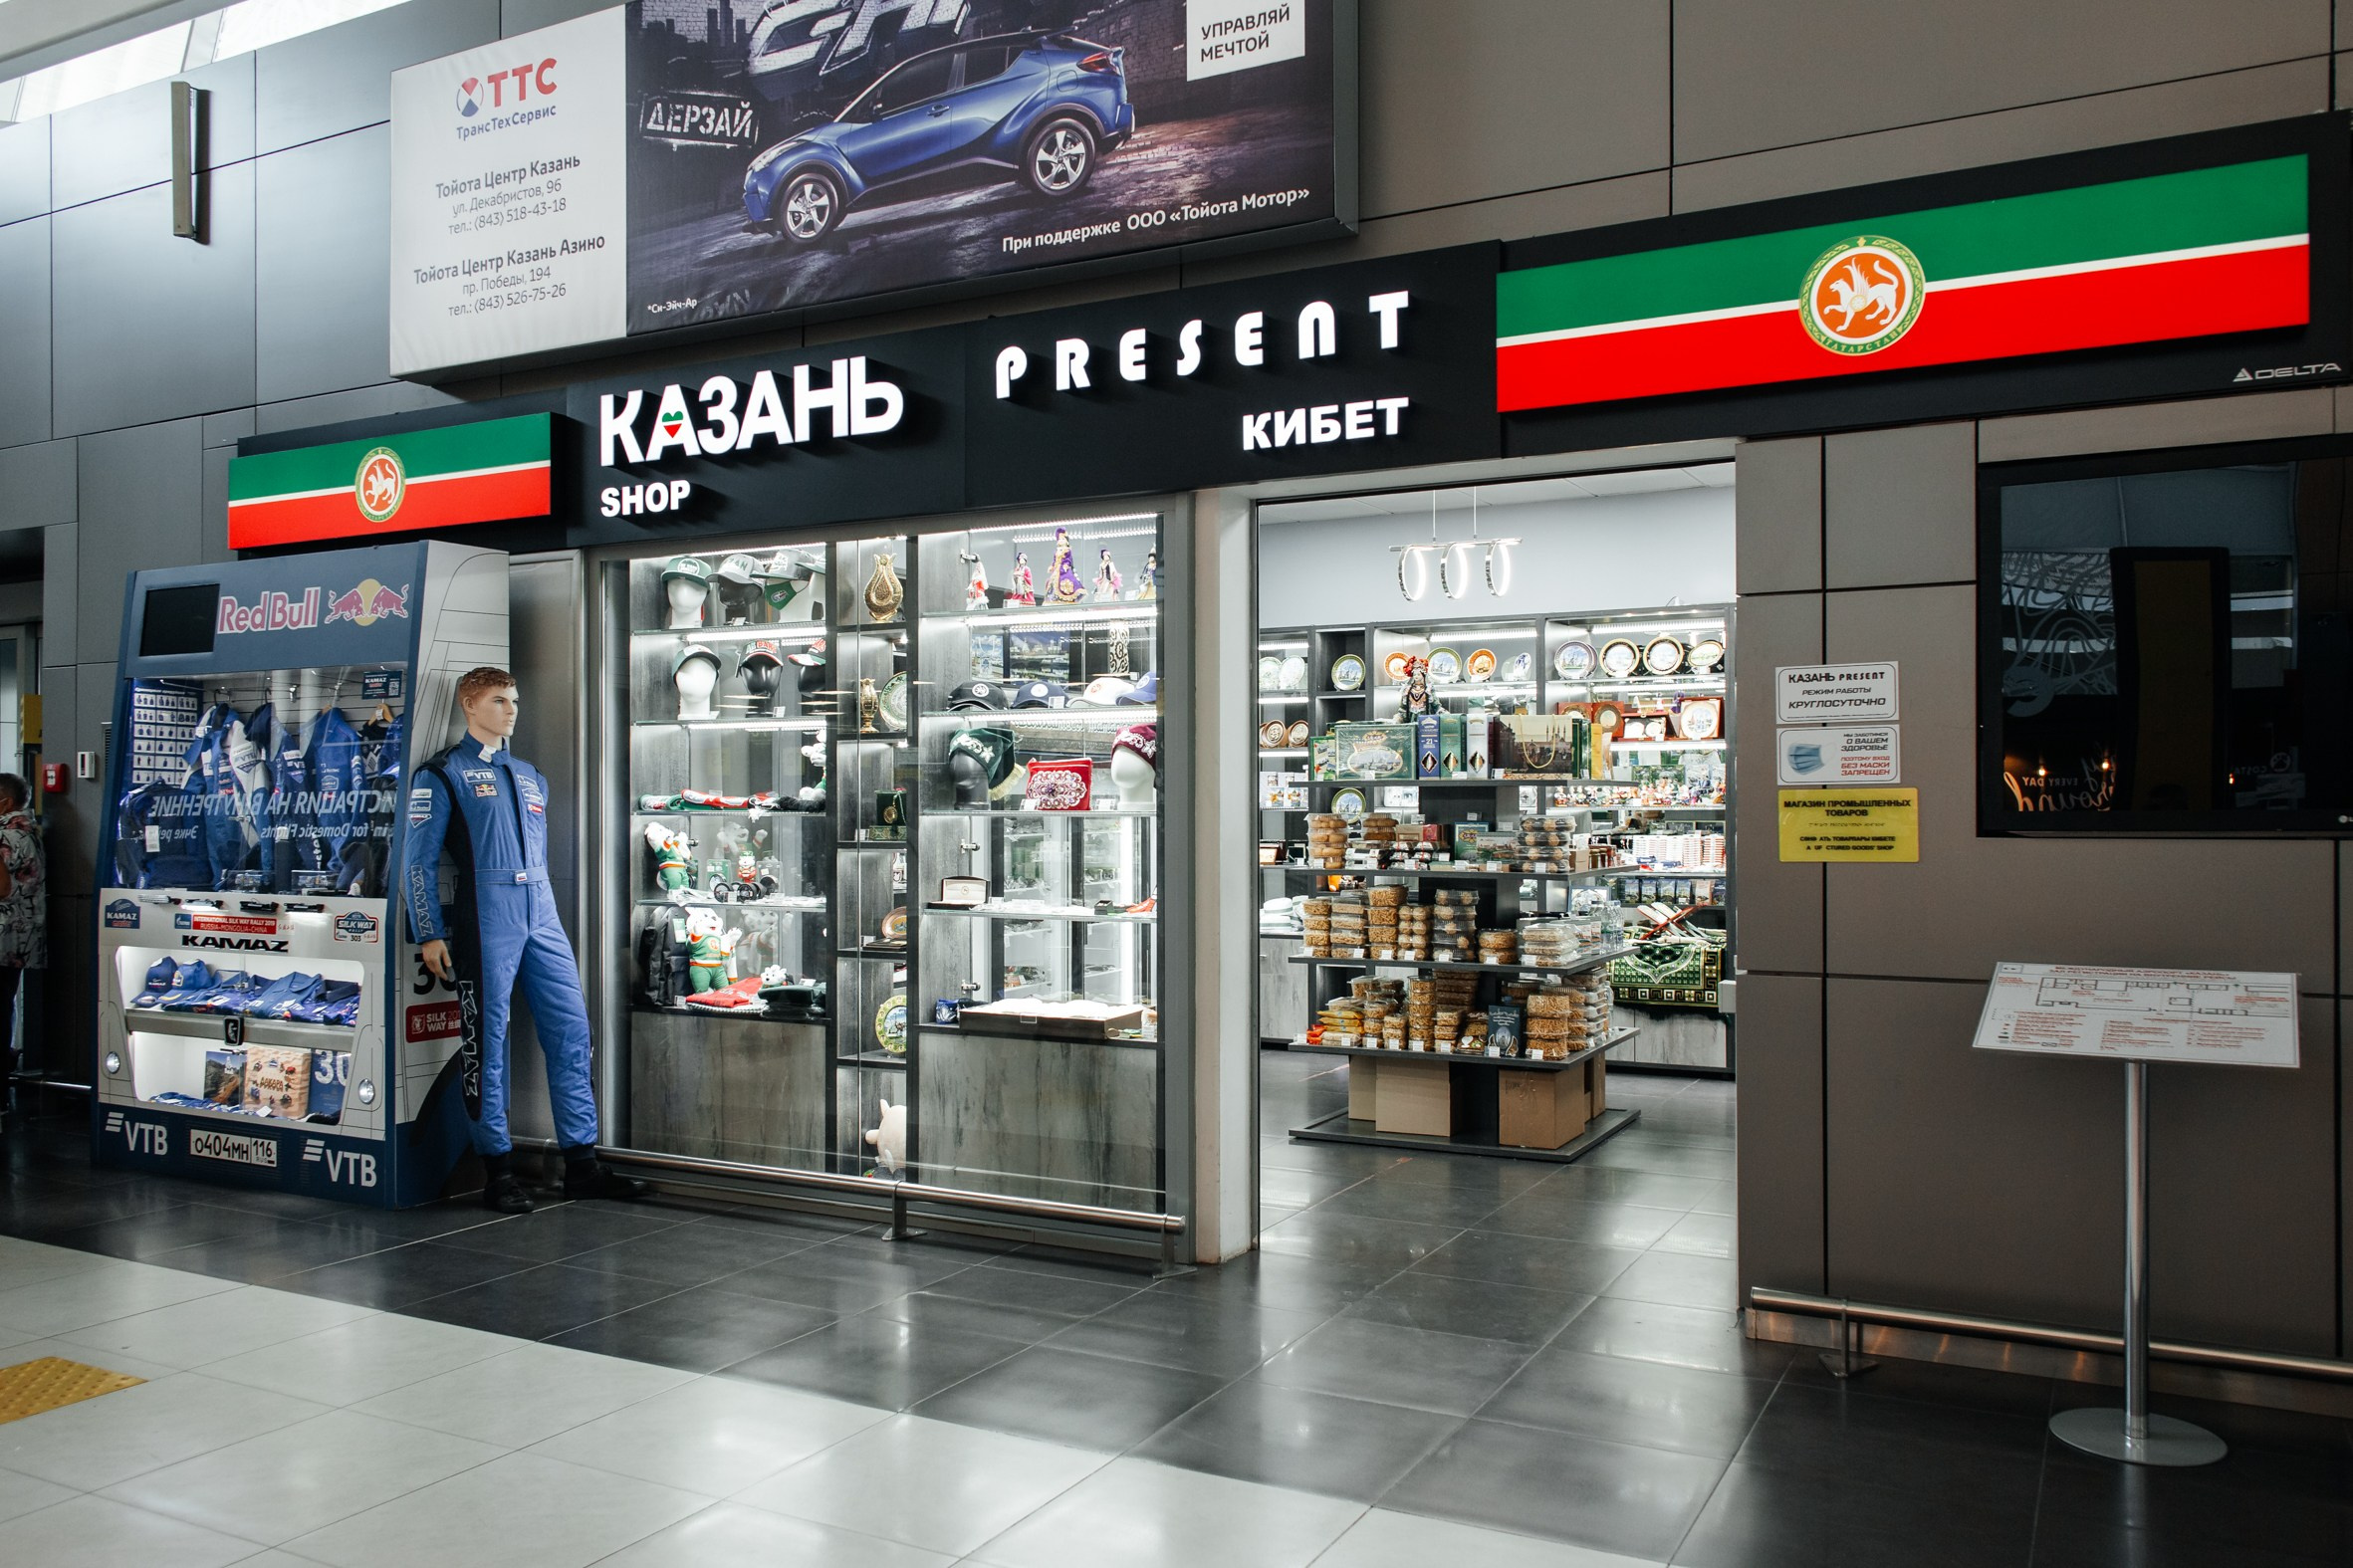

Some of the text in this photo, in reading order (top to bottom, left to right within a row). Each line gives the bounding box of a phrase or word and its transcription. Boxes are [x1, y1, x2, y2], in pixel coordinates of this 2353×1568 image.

[1200, 4, 1291, 40] УПРАВЛЯЙ
[1200, 31, 1270, 62] МЕЧТОЙ
[487, 58, 557, 108] ТТС
[456, 105, 557, 141] ТрансТехСервис
[646, 102, 754, 138] ДЕРЗАЙ
[436, 155, 581, 199] Тойота Центр Казань
[448, 197, 567, 235] тел.: (843) 518-43-18
[452, 178, 563, 218] ул. Декабристов, 96
[1003, 187, 1310, 254] При поддержке ООО «Тойота Мотор»
[413, 235, 605, 285] Тойота Центр Казань Азино
[463, 266, 552, 297] пр. Победы, 194
[448, 283, 567, 317] тел.: (843) 526-75-26
[996, 290, 1409, 399] PRESENT
[1824, 331, 1898, 354] ТАТАРСТАН
[2254, 362, 2342, 380] DELTA
[599, 355, 905, 467] КАЗАНЬ
[1242, 396, 1409, 451] КИБЕТ
[600, 479, 691, 518] SHOP
[217, 586, 321, 634] Red Bull
[1788, 672, 1885, 683] КАЗАНЬ PRESENT
[1788, 698, 1886, 709] КРУГЛОСУТОЧНО
[107, 912, 138, 921] KAMAZ
[410, 864, 435, 936] KAMAZ
[338, 920, 356, 929] SILK
[181, 935, 289, 953] KAMAZ
[426, 1011, 446, 1022] SILK
[427, 1021, 446, 1032] WAY
[458, 980, 480, 1096] KAMAZ
[124, 1121, 169, 1156] VTB
[253, 1140, 273, 1157] 116
[326, 1149, 377, 1188] VTB
